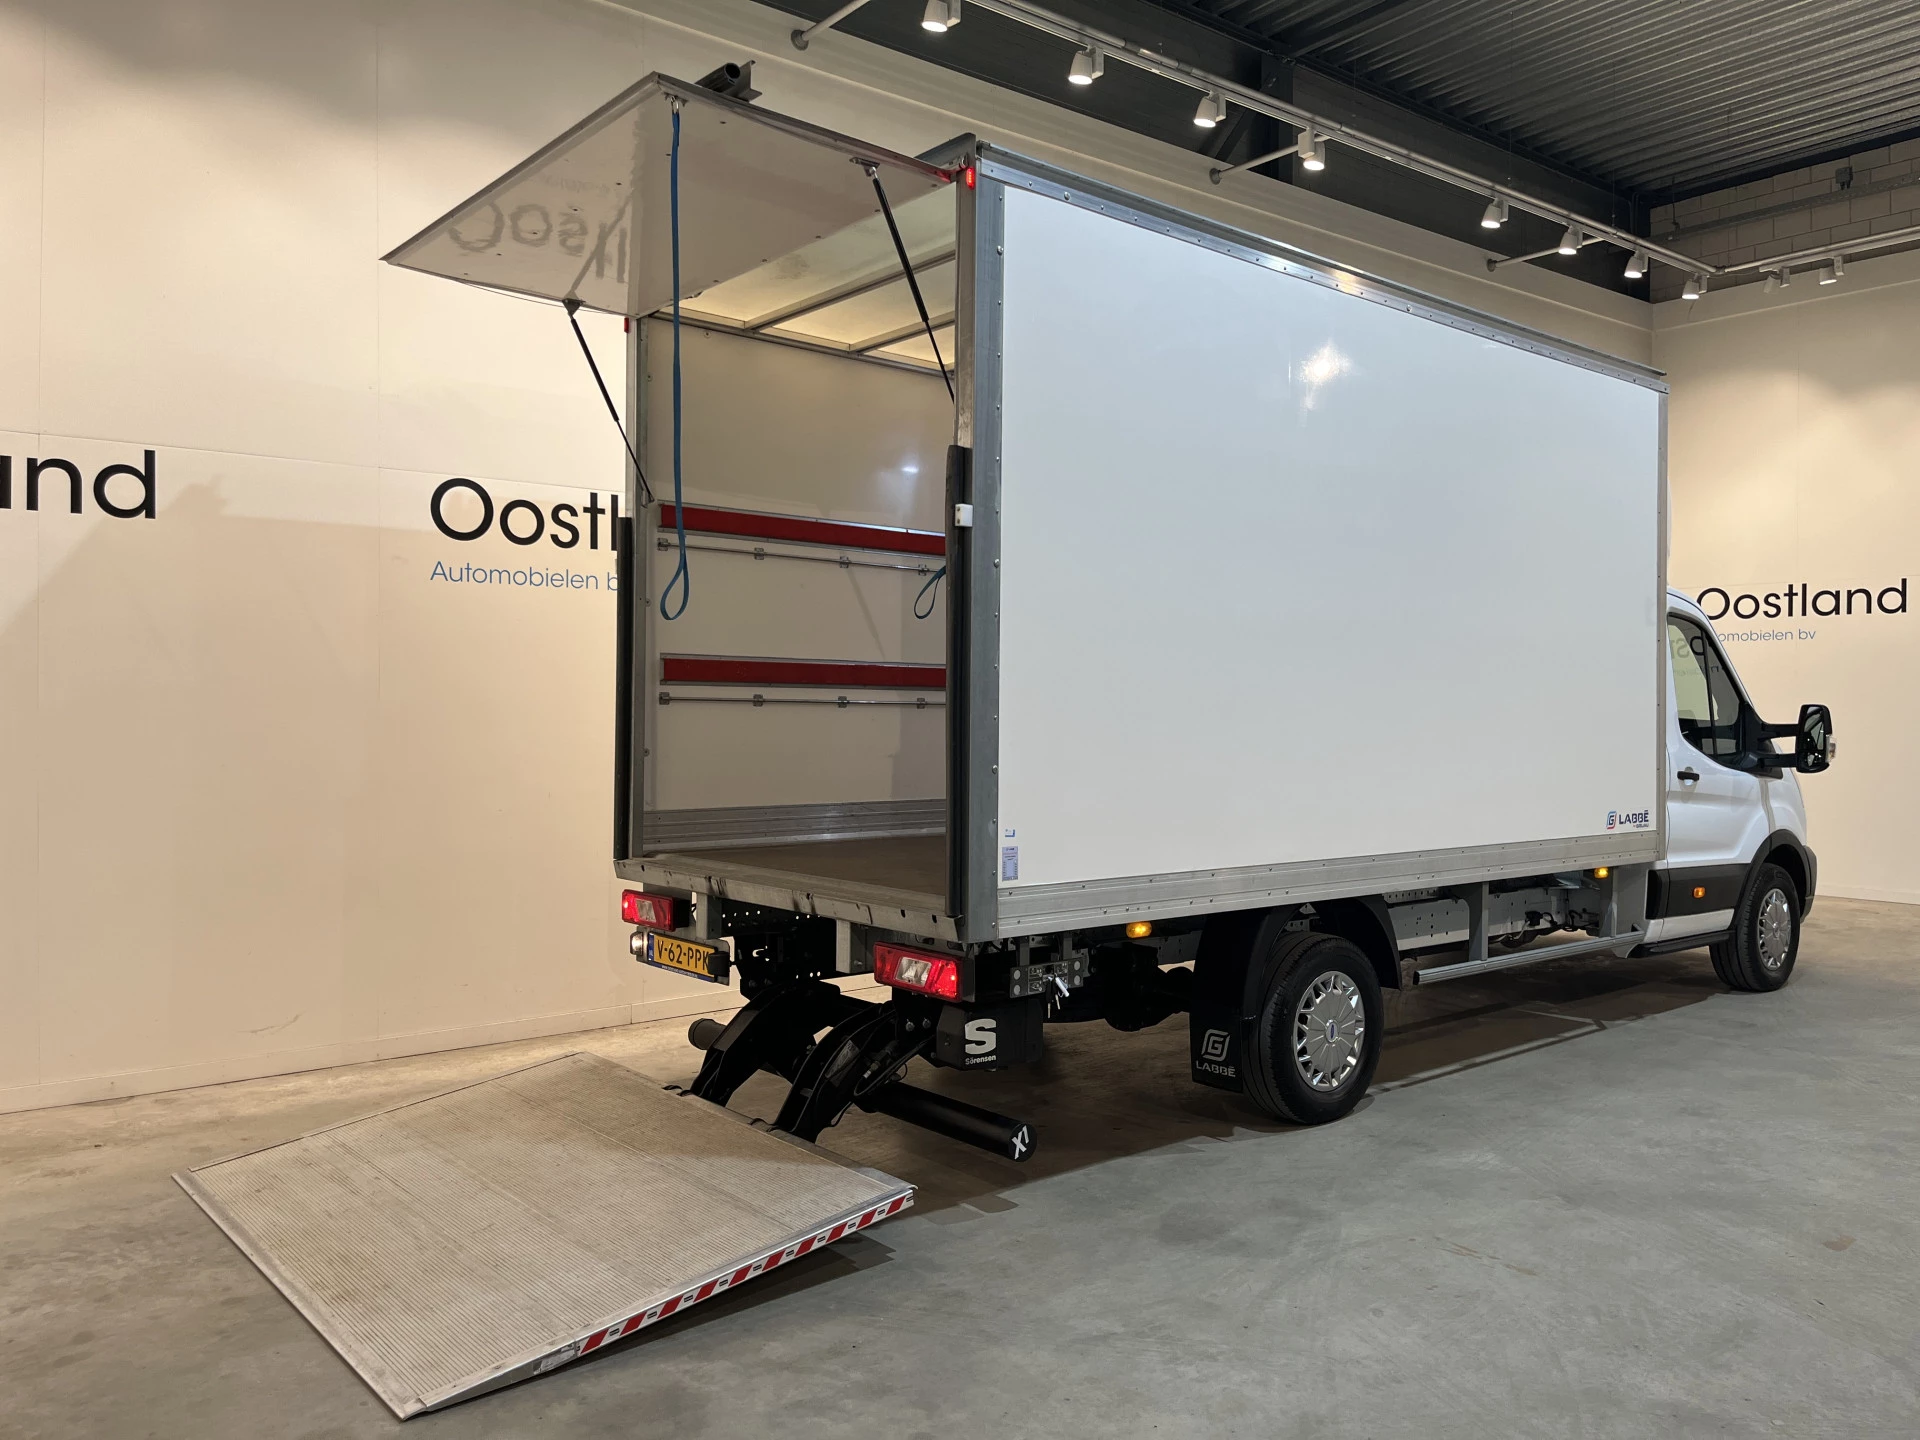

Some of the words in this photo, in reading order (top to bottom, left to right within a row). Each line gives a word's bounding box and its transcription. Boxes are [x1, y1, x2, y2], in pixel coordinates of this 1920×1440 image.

[0, 449, 156, 519] nd
[430, 560, 598, 590] Automobielen
[1697, 578, 1907, 620] Oostland
[1798, 628, 1816, 641] bv
[965, 1054, 997, 1066] Sörensen
